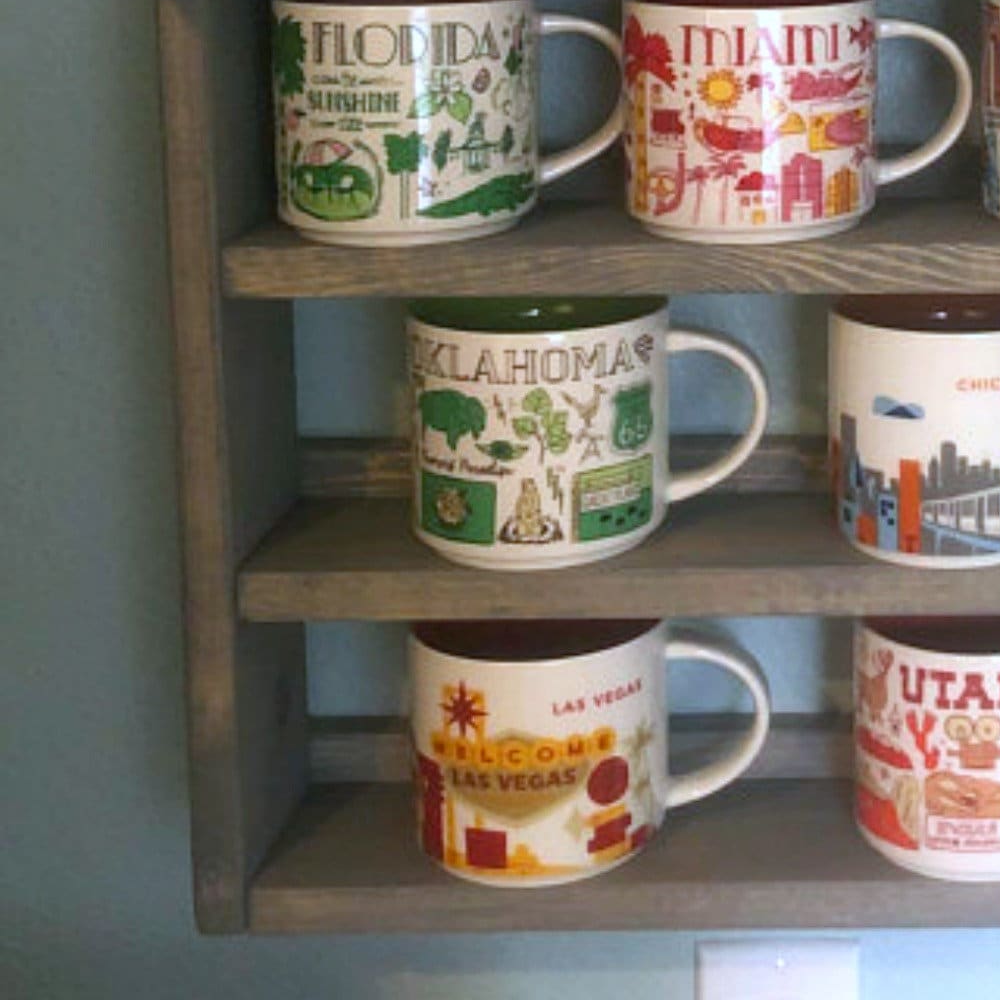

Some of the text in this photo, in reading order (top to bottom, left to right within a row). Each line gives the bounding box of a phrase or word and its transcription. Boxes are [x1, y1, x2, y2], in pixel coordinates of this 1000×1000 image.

[311, 20, 501, 67] FLORIDA
[680, 23, 840, 67] MIAMI
[552, 677, 643, 716] LAS VEGAS
[452, 767, 577, 792] LAS VEGAS
